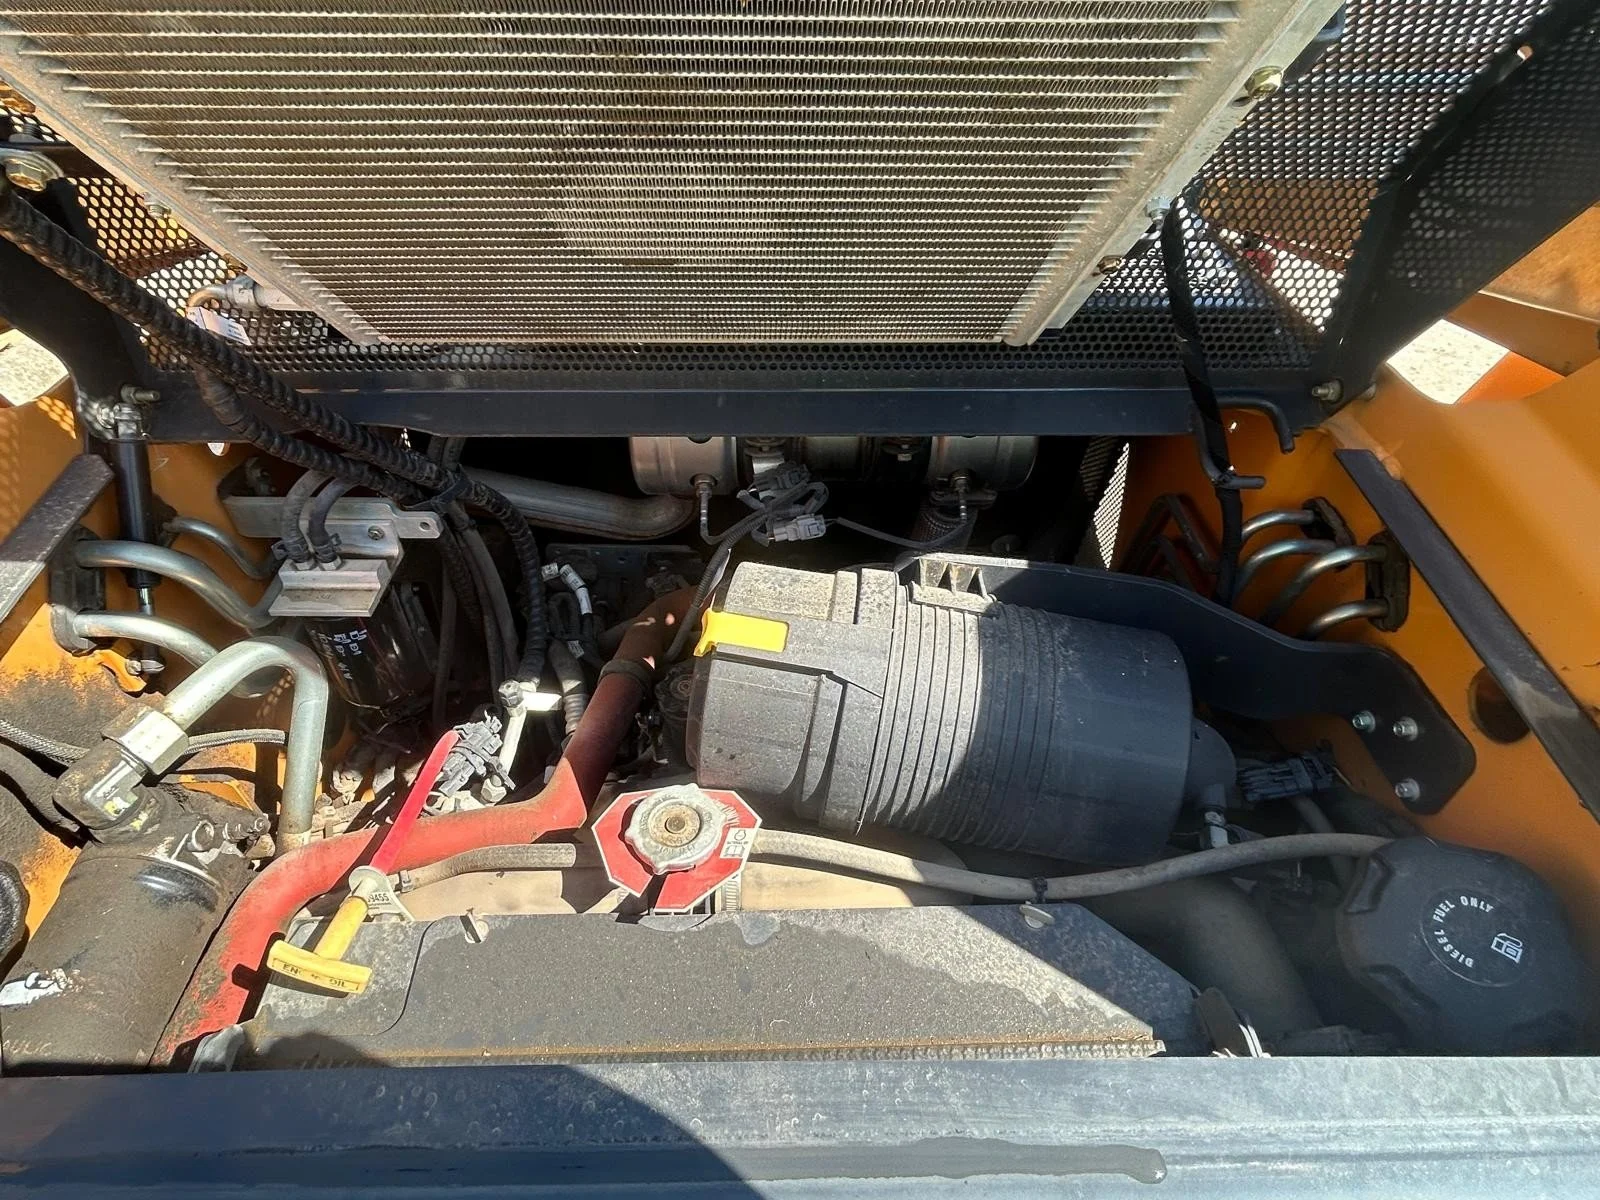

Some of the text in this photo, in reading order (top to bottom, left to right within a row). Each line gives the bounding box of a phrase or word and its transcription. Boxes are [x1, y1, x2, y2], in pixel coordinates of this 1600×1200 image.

[1433, 895, 1494, 968] DIESEL FUEL ONLY
